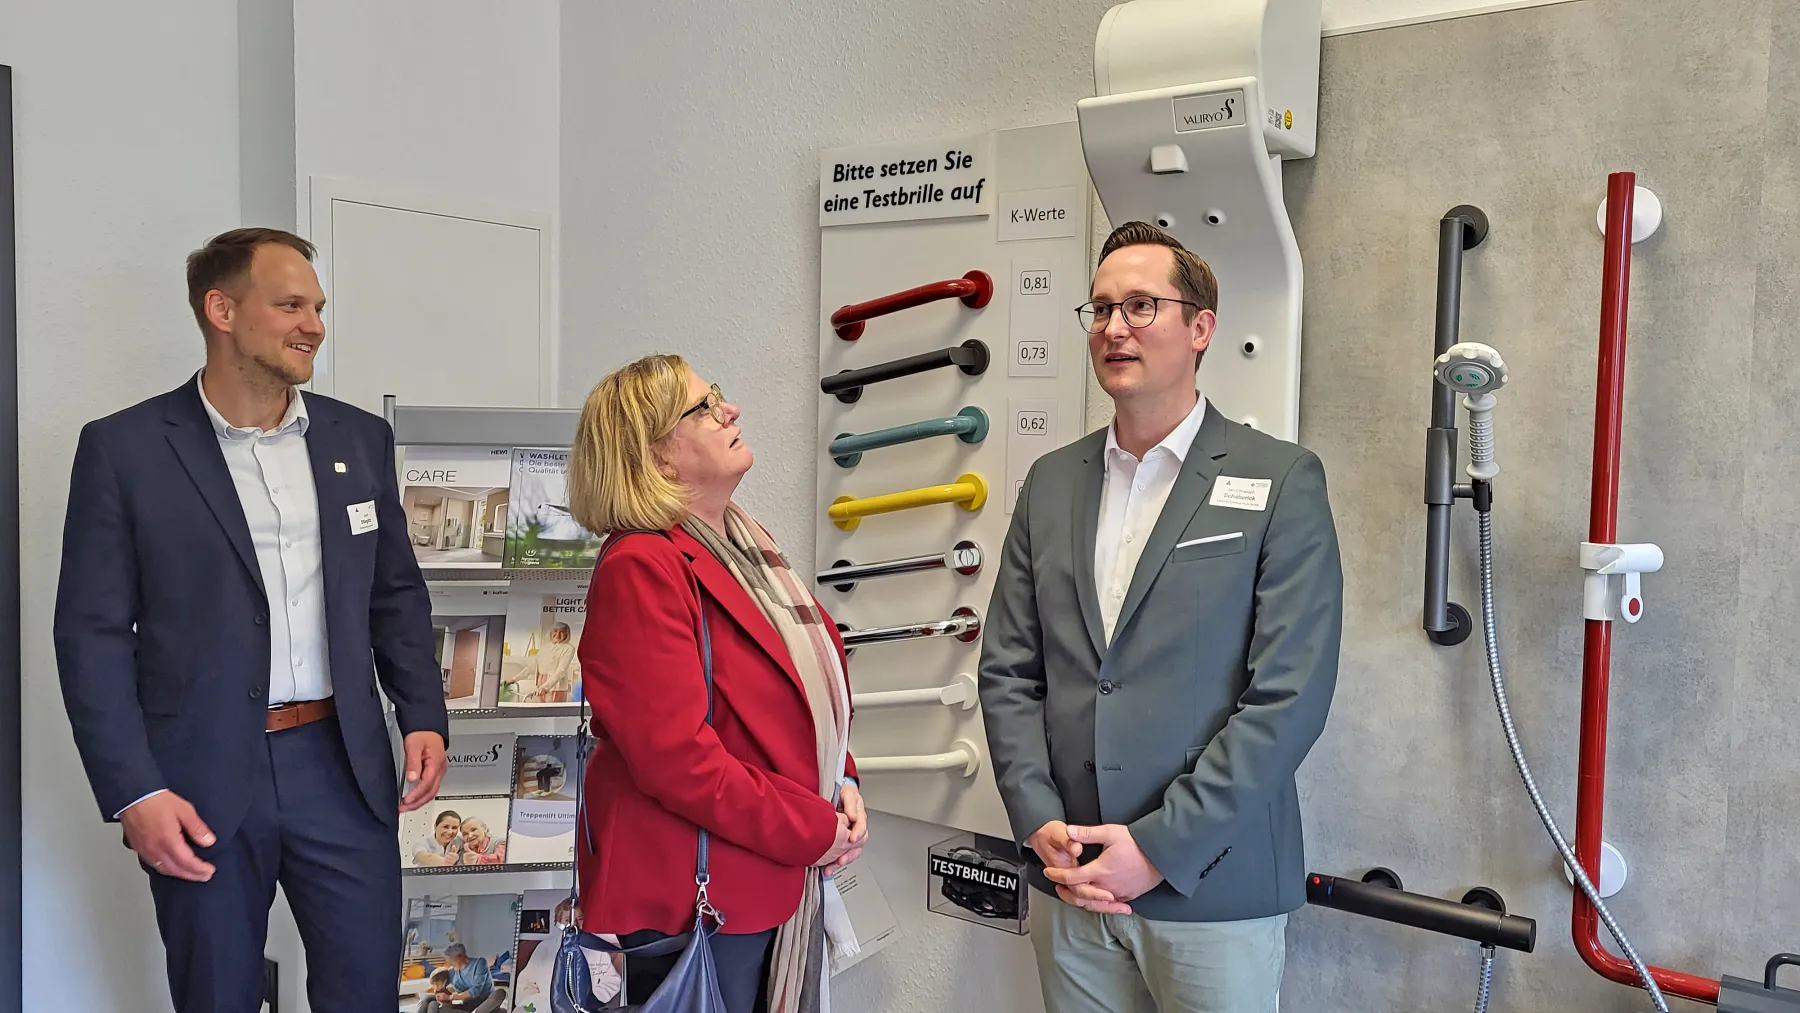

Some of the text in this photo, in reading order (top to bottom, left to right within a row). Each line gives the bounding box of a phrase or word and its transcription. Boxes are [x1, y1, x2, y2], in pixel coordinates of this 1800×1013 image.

[1183, 111, 1223, 125] VALIRYO
[833, 151, 972, 182] Bitte setzen Sie
[824, 178, 985, 212] eine Testbrille auf
[1011, 207, 1065, 223] K-Werte
[1023, 276, 1048, 292] 0,81
[1021, 346, 1046, 362] 0,73
[1020, 417, 1045, 431] 0,62
[406, 469, 457, 482] CARE
[520, 811, 556, 819] Treppenlift
[932, 858, 1017, 891] TESTBRILLEN
